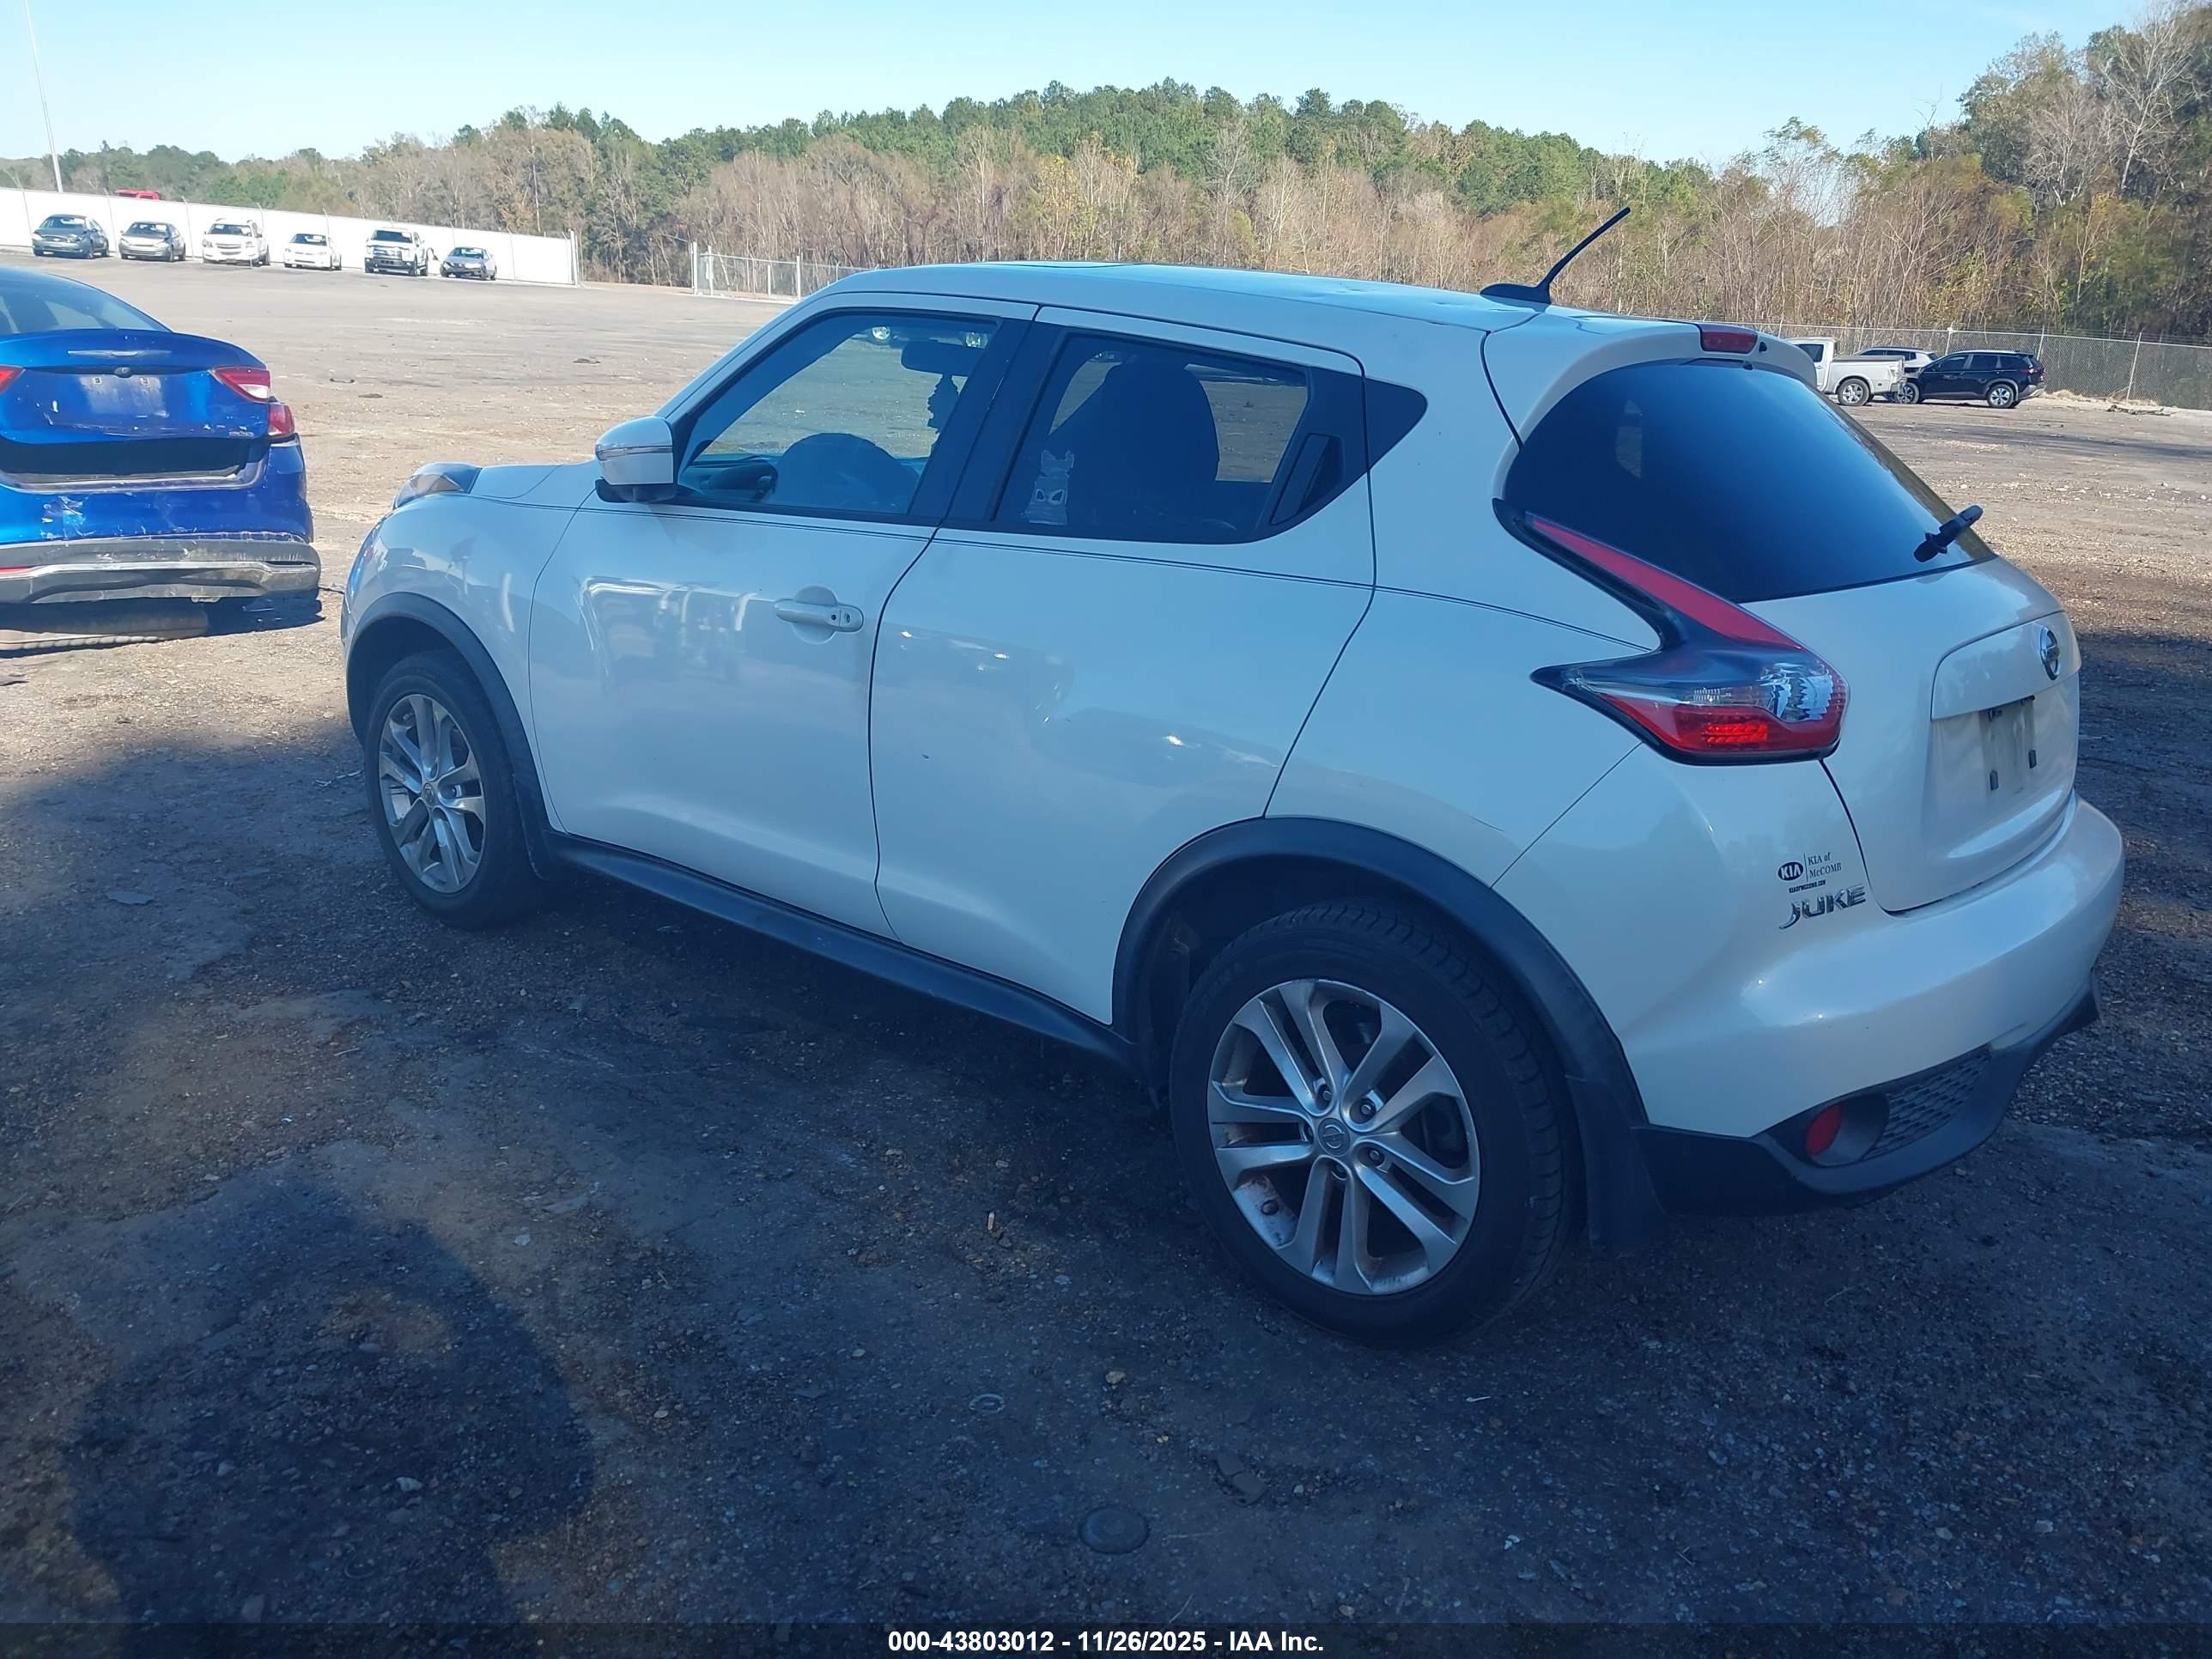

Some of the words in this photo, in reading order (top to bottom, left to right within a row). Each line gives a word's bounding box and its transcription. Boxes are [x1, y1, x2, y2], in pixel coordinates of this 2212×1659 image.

[1808, 854, 1823, 866] KIA
[1824, 852, 1831, 862] of
[1779, 863, 1802, 879] KIA
[1808, 862, 1842, 878] McCOMB
[1778, 884, 1867, 930] JUKE
